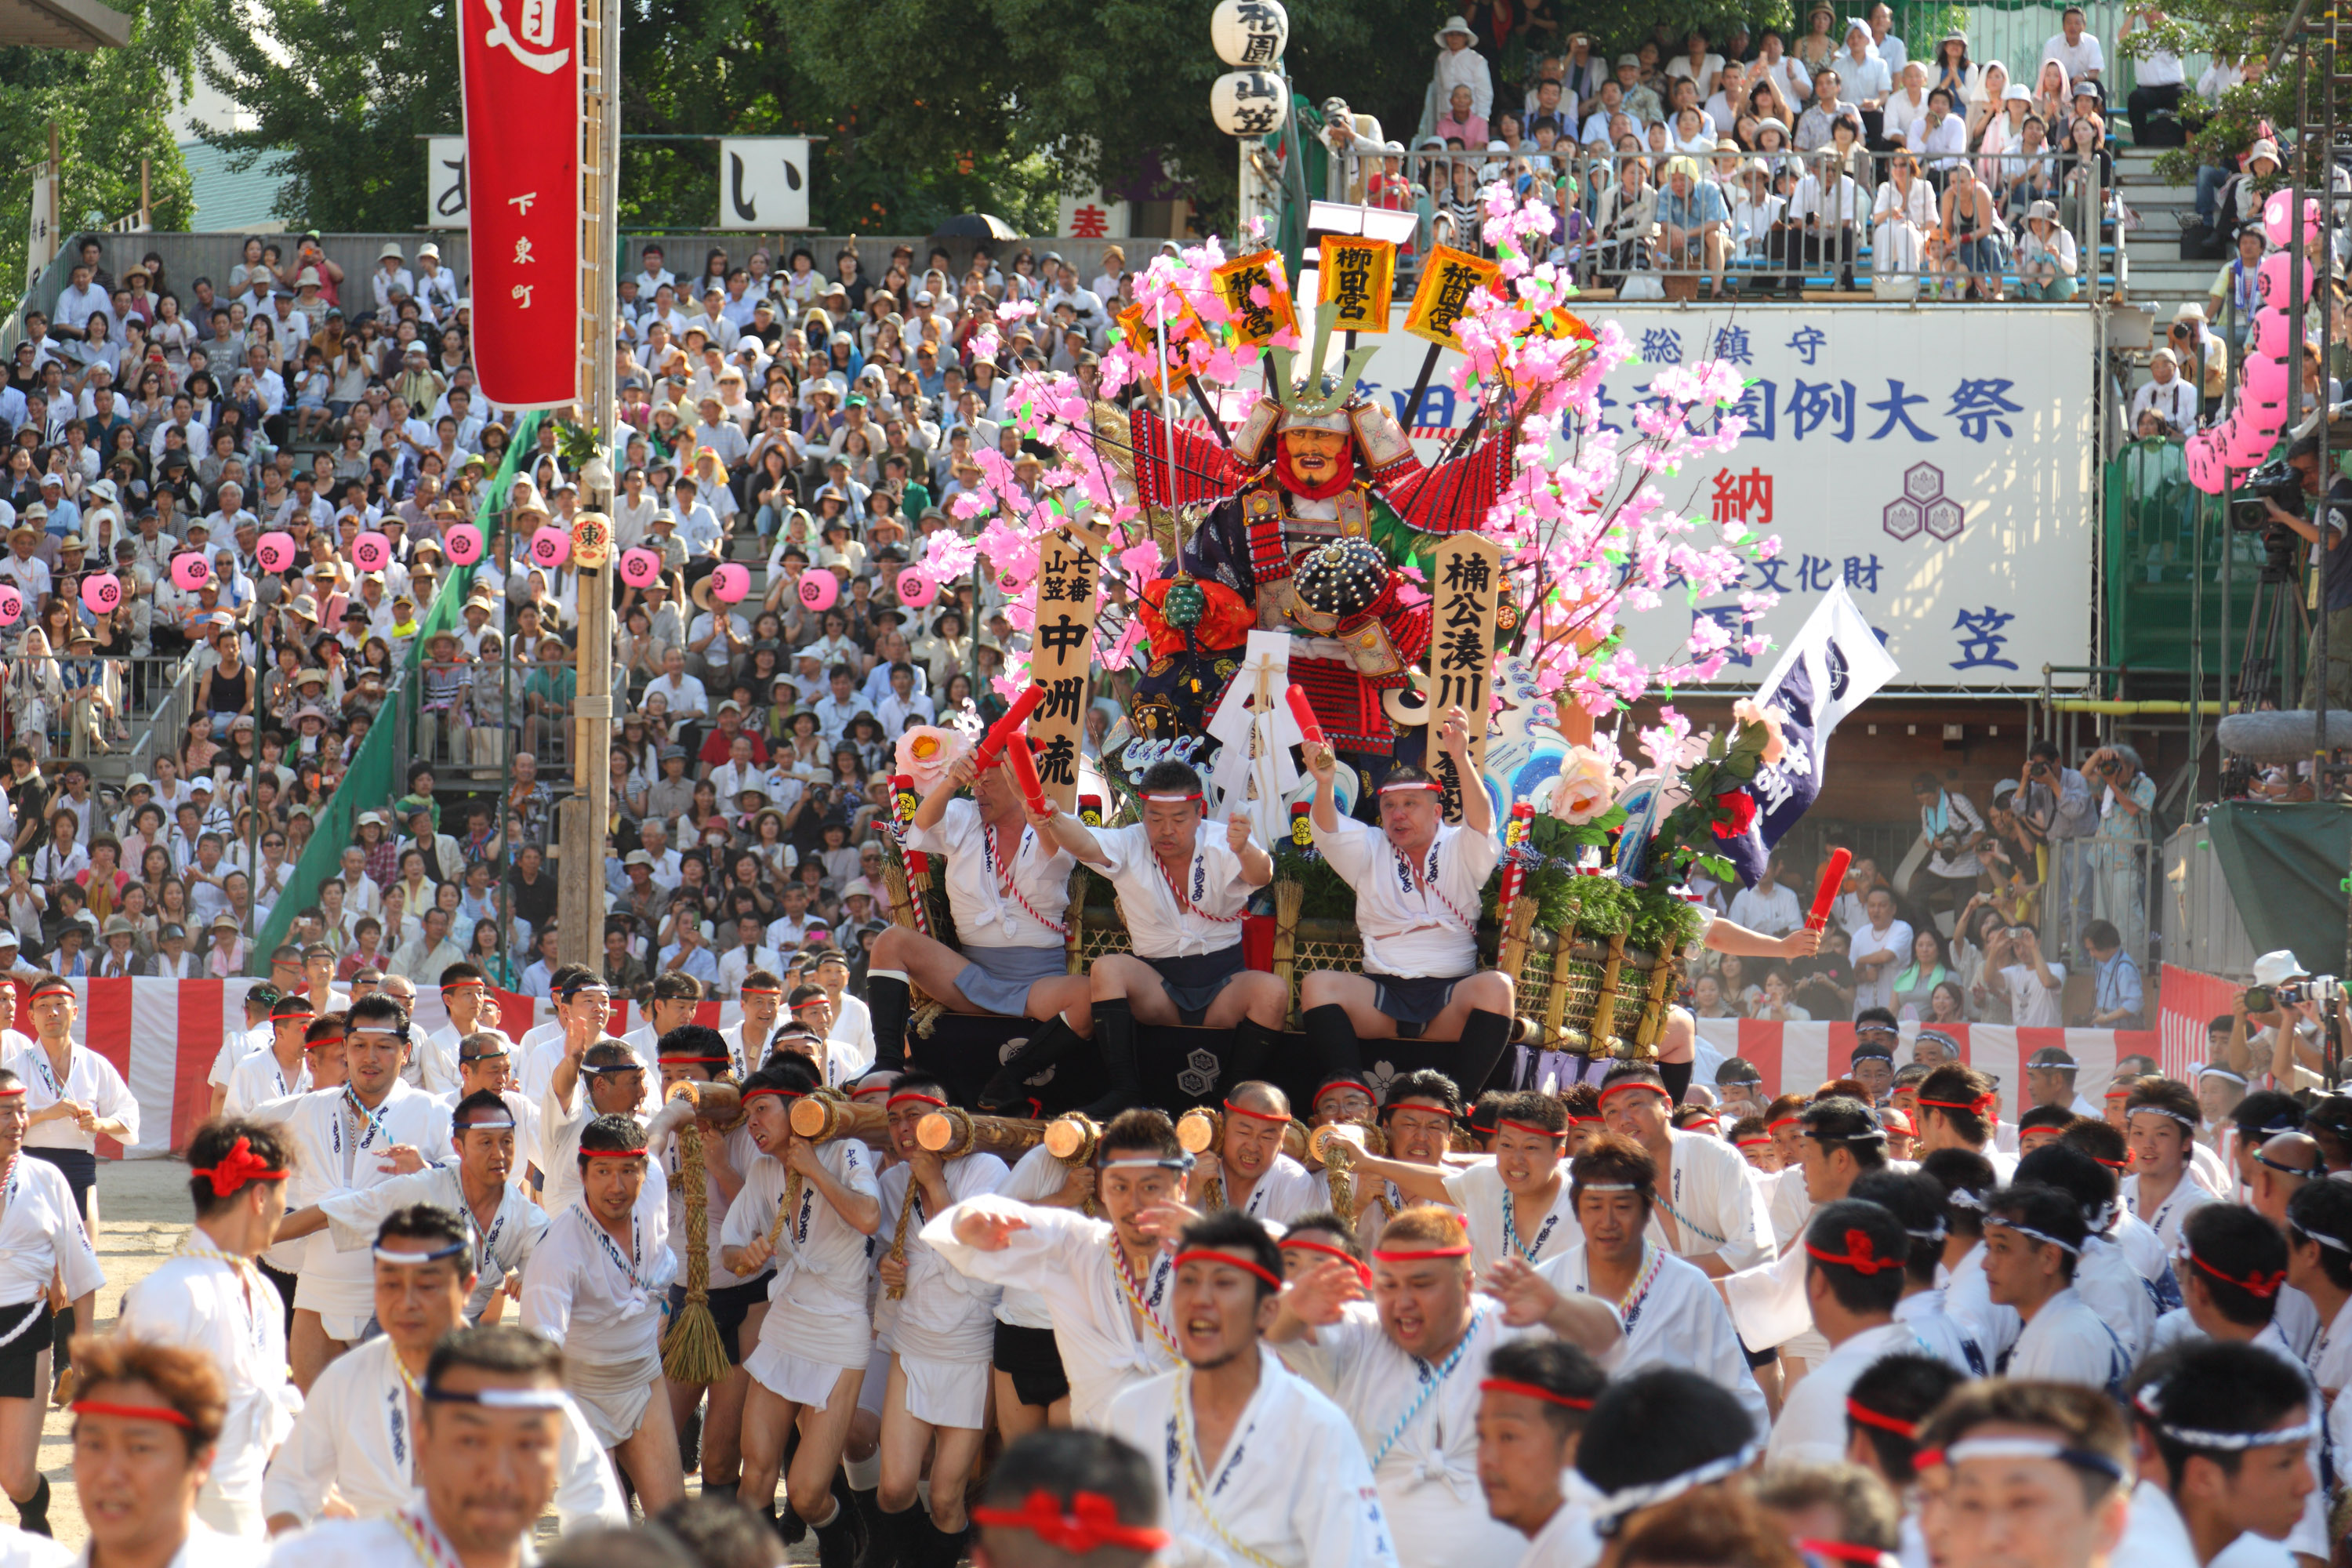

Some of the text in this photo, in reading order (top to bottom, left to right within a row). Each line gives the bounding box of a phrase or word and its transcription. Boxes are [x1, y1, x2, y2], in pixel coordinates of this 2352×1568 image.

[1234, 73, 1279, 133] 山笠
[730, 151, 801, 222] い
[508, 191, 537, 309] 下東町
[1334, 247, 1373, 320] 櫛田宮
[1590, 325, 1828, 365] 総鎮守
[581, 524, 599, 546] 東
[1042, 550, 1069, 602] 山笠
[1065, 550, 1096, 603] 七番
[1033, 614, 1089, 786] 中洲流
[846, 1149, 859, 1171] 中五
